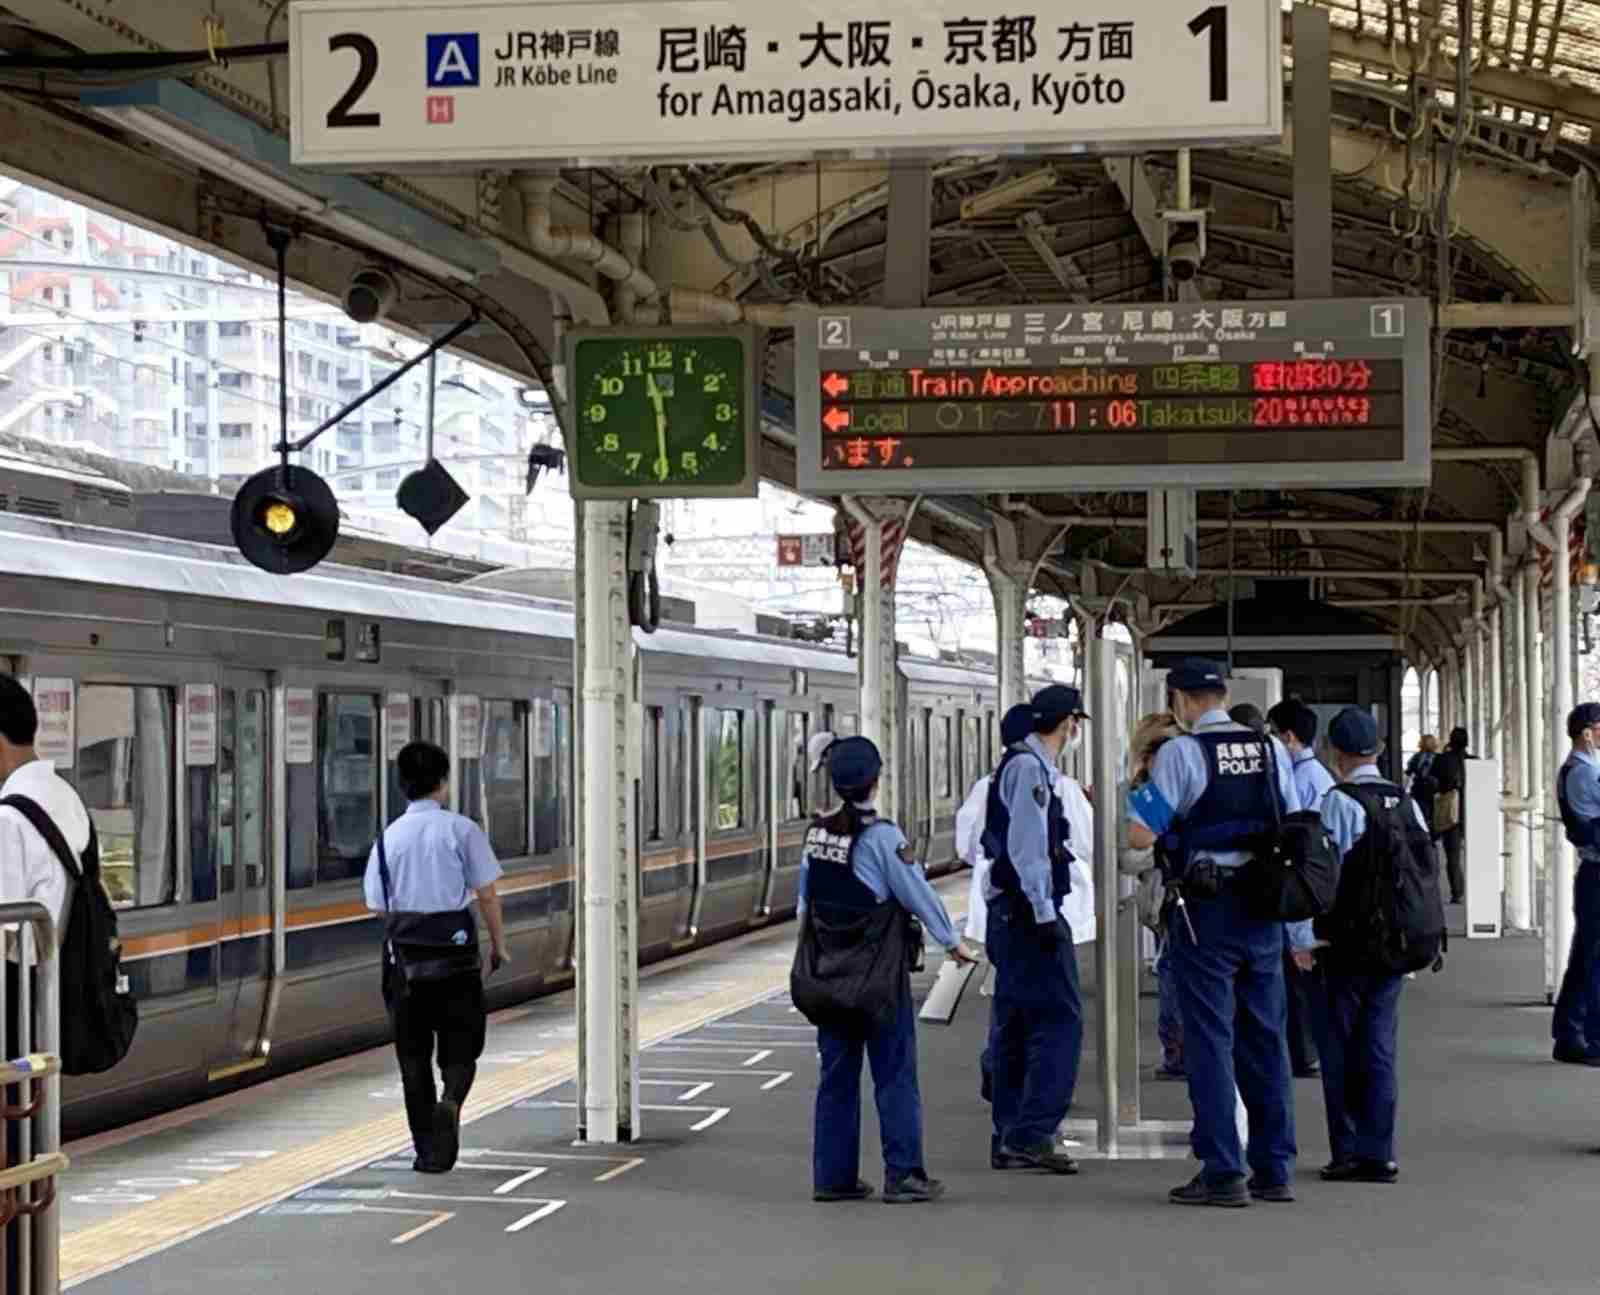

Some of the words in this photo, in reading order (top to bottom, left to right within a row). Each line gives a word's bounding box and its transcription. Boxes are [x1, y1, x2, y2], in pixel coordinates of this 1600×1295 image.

[495, 29, 619, 60] JR神戸線
[1058, 21, 1134, 61] 方面
[434, 40, 472, 81] A
[1187, 5, 1229, 102] 1
[327, 32, 381, 128] 2
[495, 67, 515, 87] JR
[577, 64, 618, 84] Line
[657, 82, 701, 117] for
[711, 76, 902, 122] Amagasaki,
[912, 70, 1021, 113] Ōsaka,
[1032, 72, 1125, 114] Kyōto
[1378, 309, 1392, 333] 1
[826, 321, 844, 345] 2
[622, 352, 643, 376] 11
[648, 351, 673, 368] 12
[601, 377, 624, 395] 10
[703, 374, 720, 392] 2
[910, 368, 974, 397] Train
[982, 367, 1137, 397] Approaching
[590, 404, 606, 422] 9
[715, 403, 731, 421] 3
[850, 406, 909, 432] Local
[1253, 399, 1282, 426] 20
[603, 433, 619, 451] 8
[702, 433, 718, 450] 4
[625, 453, 642, 471] 7
[682, 452, 697, 469] 5
[1219, 759, 1263, 775] POLIC
[803, 843, 848, 864] POLICE
